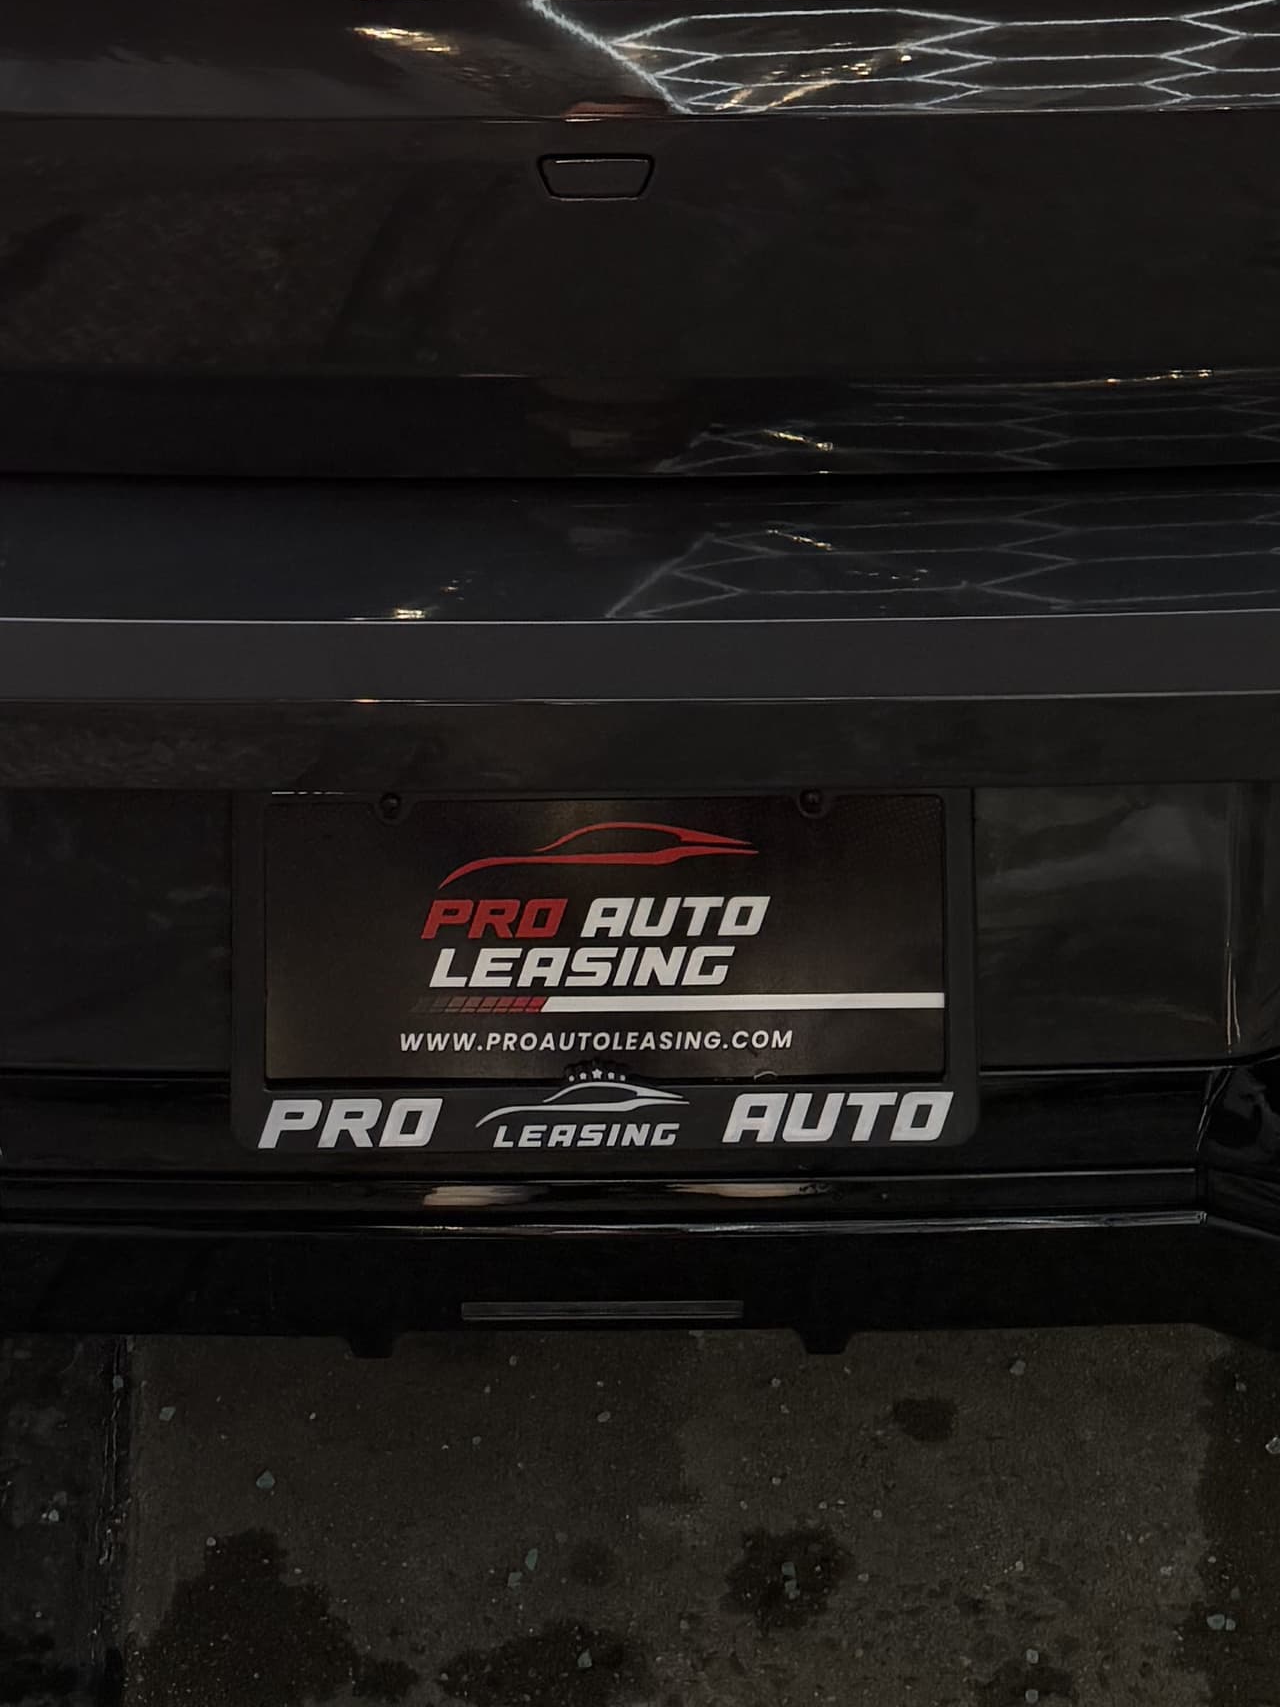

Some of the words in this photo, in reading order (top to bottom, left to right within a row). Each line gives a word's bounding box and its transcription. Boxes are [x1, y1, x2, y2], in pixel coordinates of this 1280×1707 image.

[420, 898, 569, 940] PRO
[580, 895, 771, 938] AUTO
[429, 945, 735, 988] LEASING
[399, 1029, 793, 1053] WWW.PROAUTOLEASING.COM
[257, 1098, 444, 1149] PRO
[493, 1123, 681, 1148] LEASING
[722, 1091, 955, 1143] AUTO
